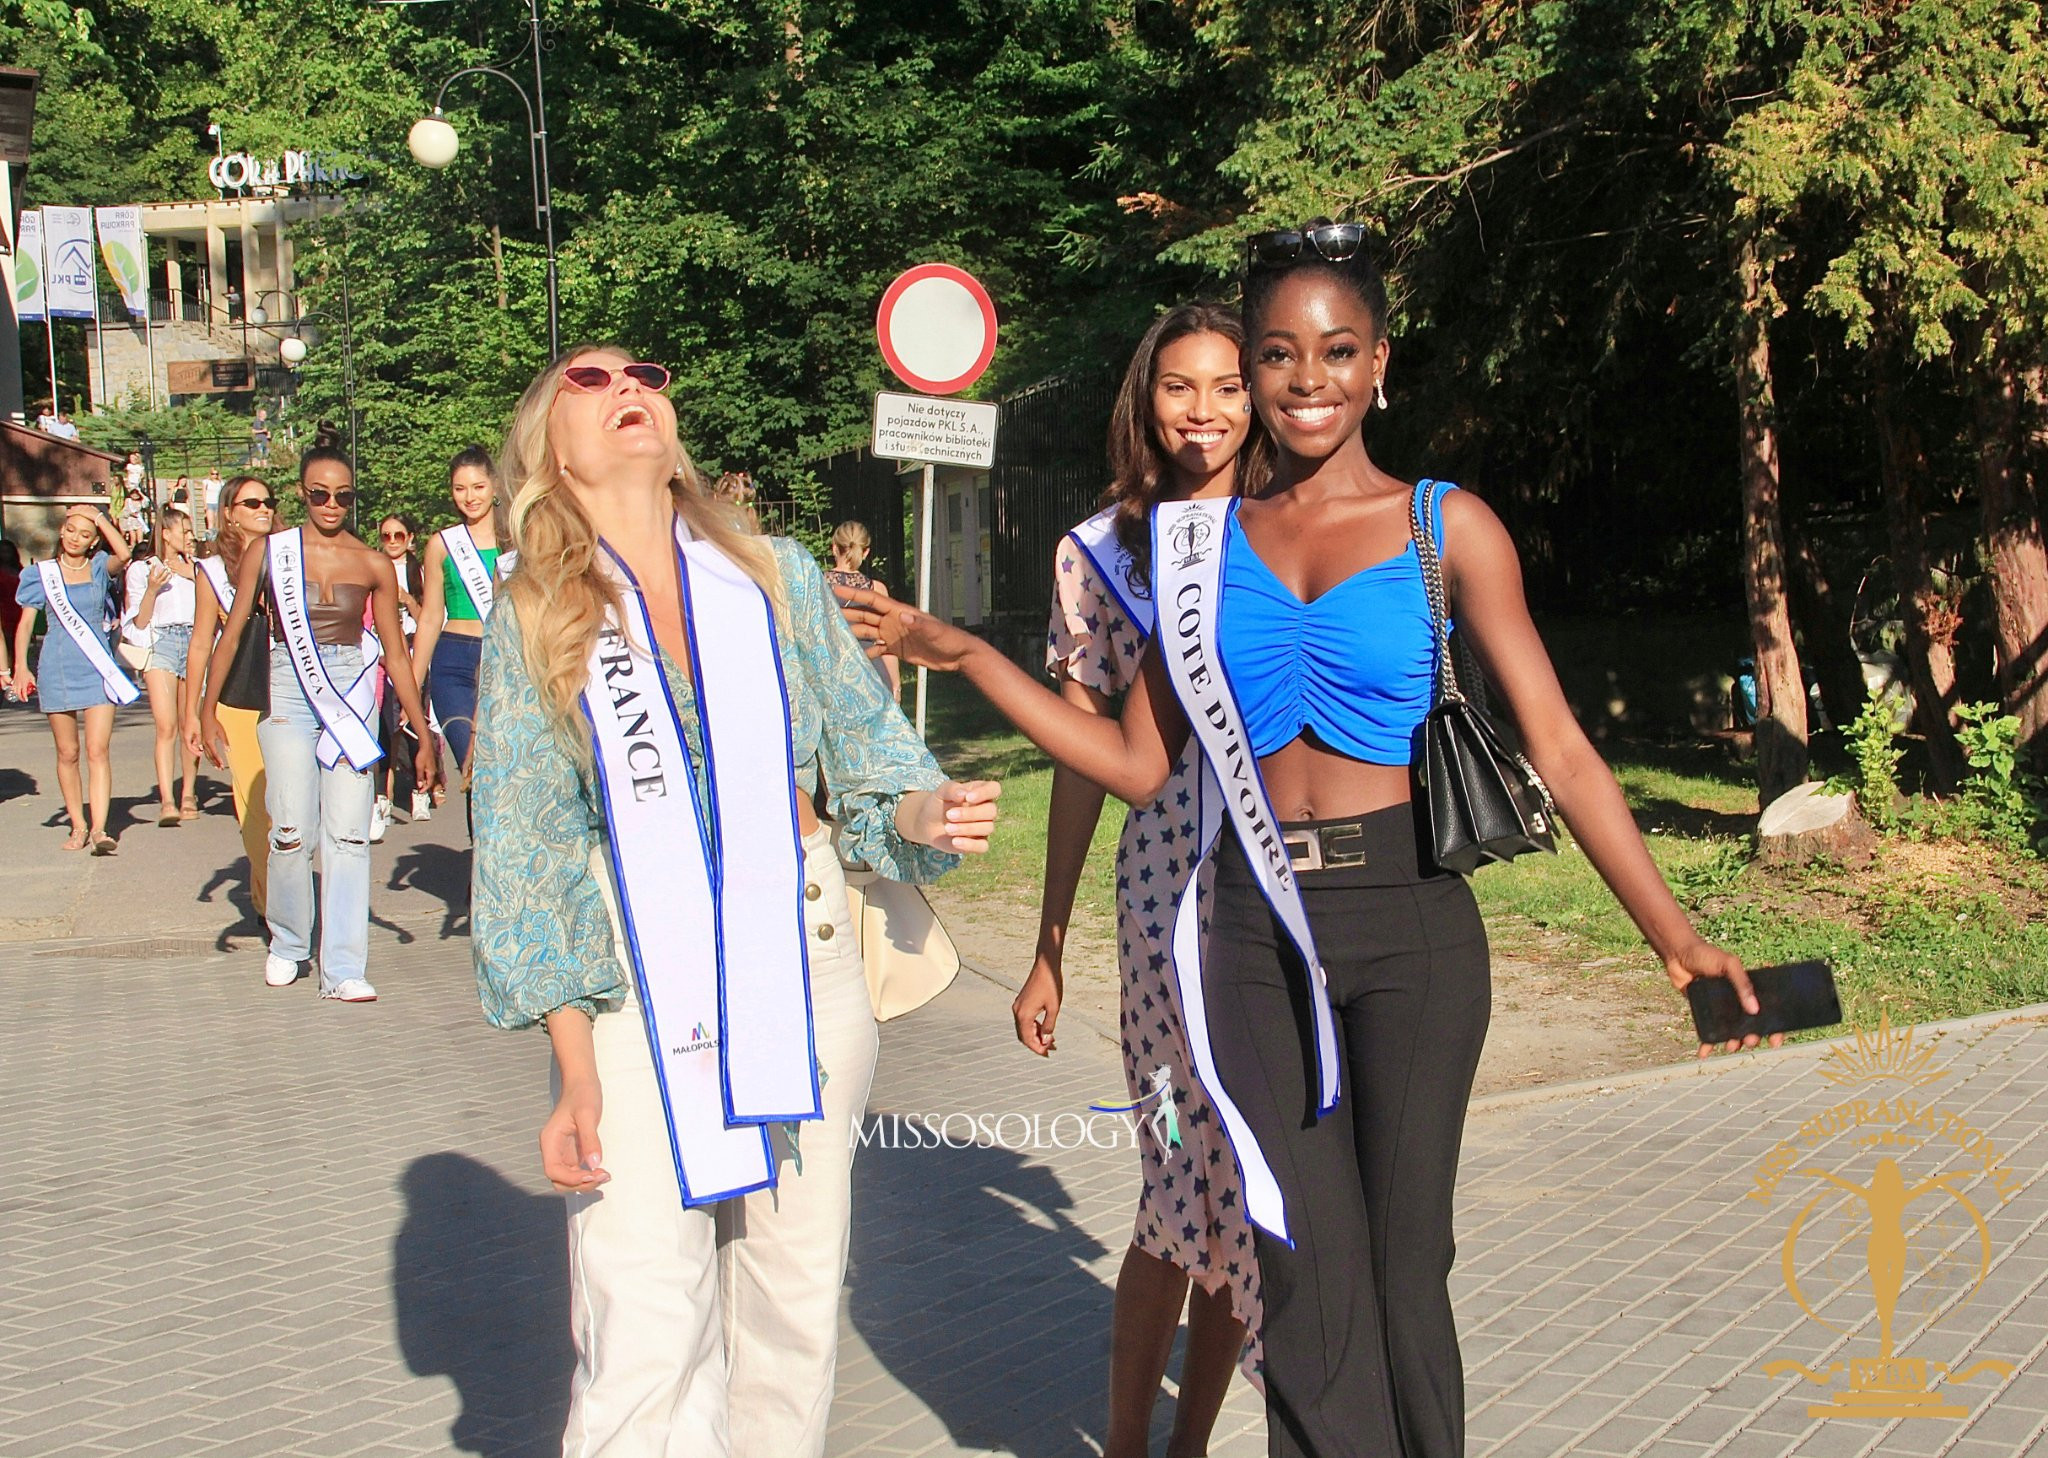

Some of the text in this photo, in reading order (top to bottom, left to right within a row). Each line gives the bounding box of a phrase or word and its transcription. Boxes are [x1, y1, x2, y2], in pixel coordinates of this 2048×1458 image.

[887, 416, 936, 429] pojazdów
[938, 421, 956, 431] PKL
[908, 402, 966, 420] Nie dotyczy
[879, 429, 991, 449] pracowników biblioteki
[468, 567, 492, 609] CHILE
[53, 592, 86, 637] ROMANIA
[281, 576, 325, 696] SOUTH AFRICA
[598, 628, 668, 803] FRANCE
[1176, 582, 1294, 892] COTE D'IVOIRE
